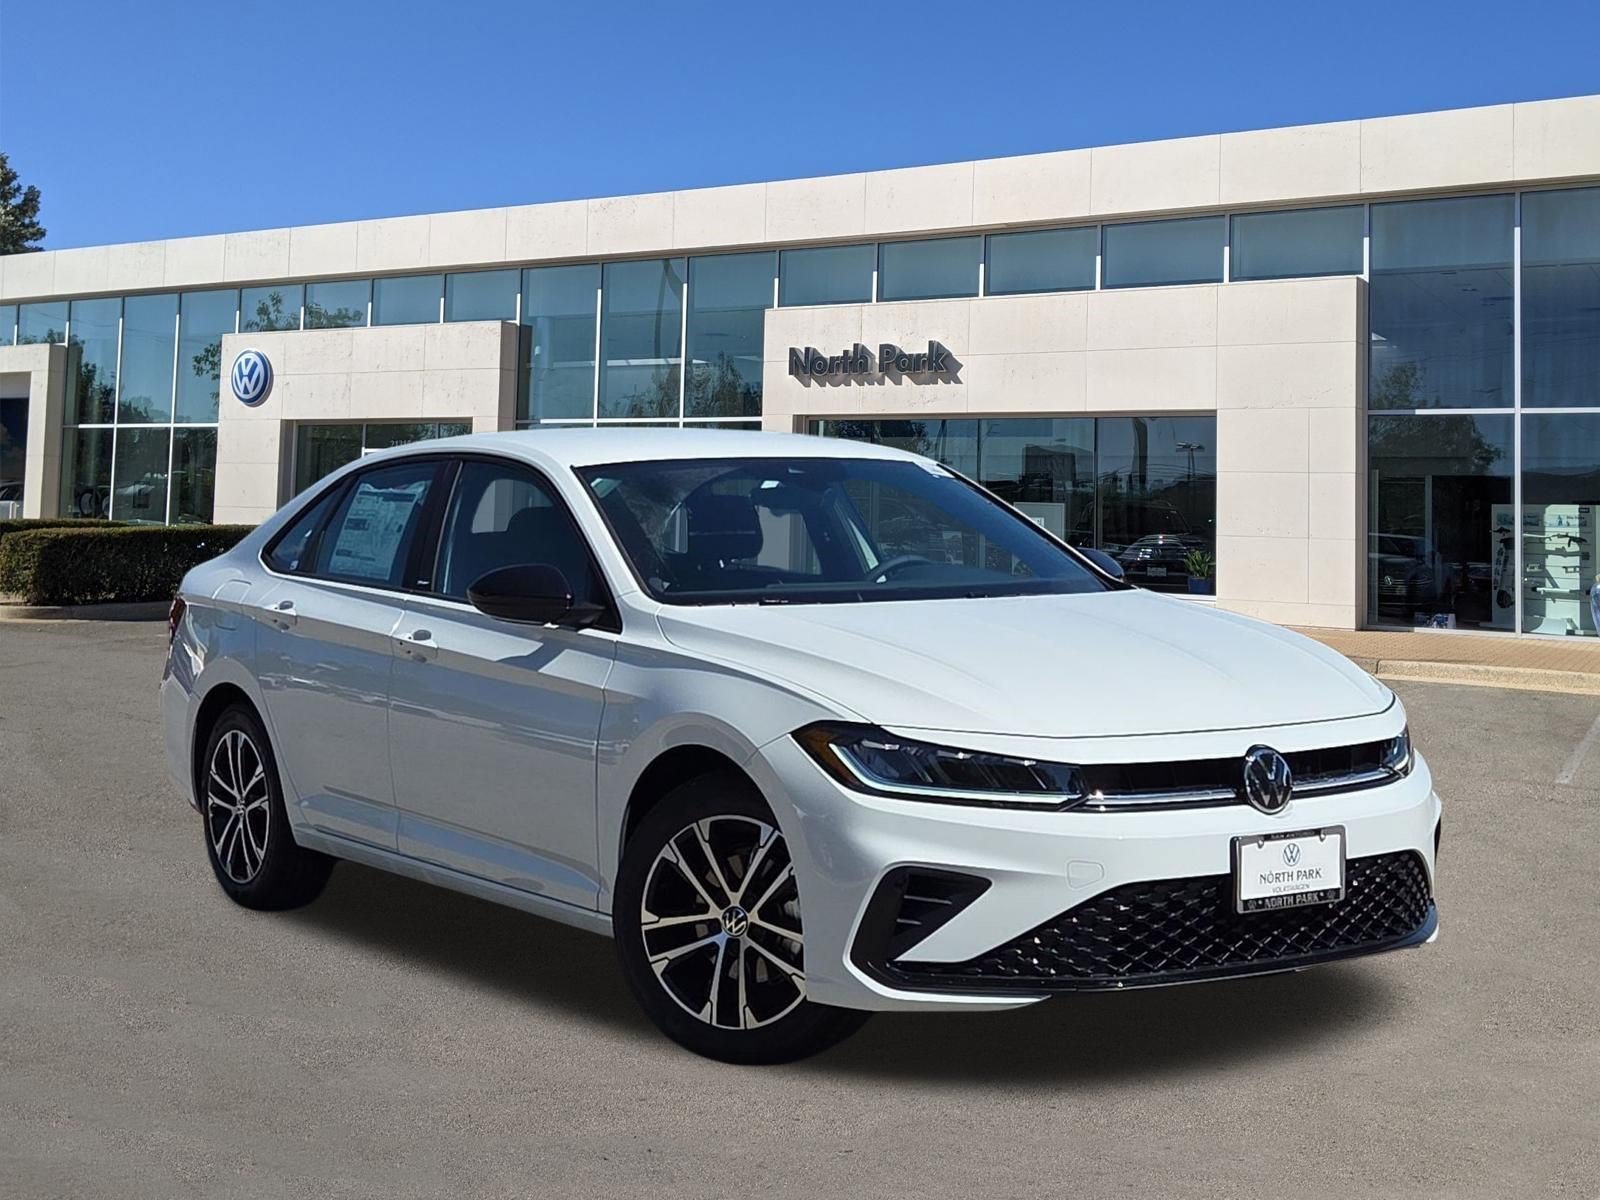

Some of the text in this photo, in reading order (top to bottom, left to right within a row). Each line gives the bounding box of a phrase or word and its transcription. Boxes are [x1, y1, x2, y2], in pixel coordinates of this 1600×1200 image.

[788, 340, 949, 376] North Park
[232, 351, 268, 403] VW
[1283, 842, 1301, 867] VW
[1259, 867, 1322, 884] NORTH PARK
[1264, 895, 1294, 908] NORTH
[1296, 892, 1319, 905] PARK
